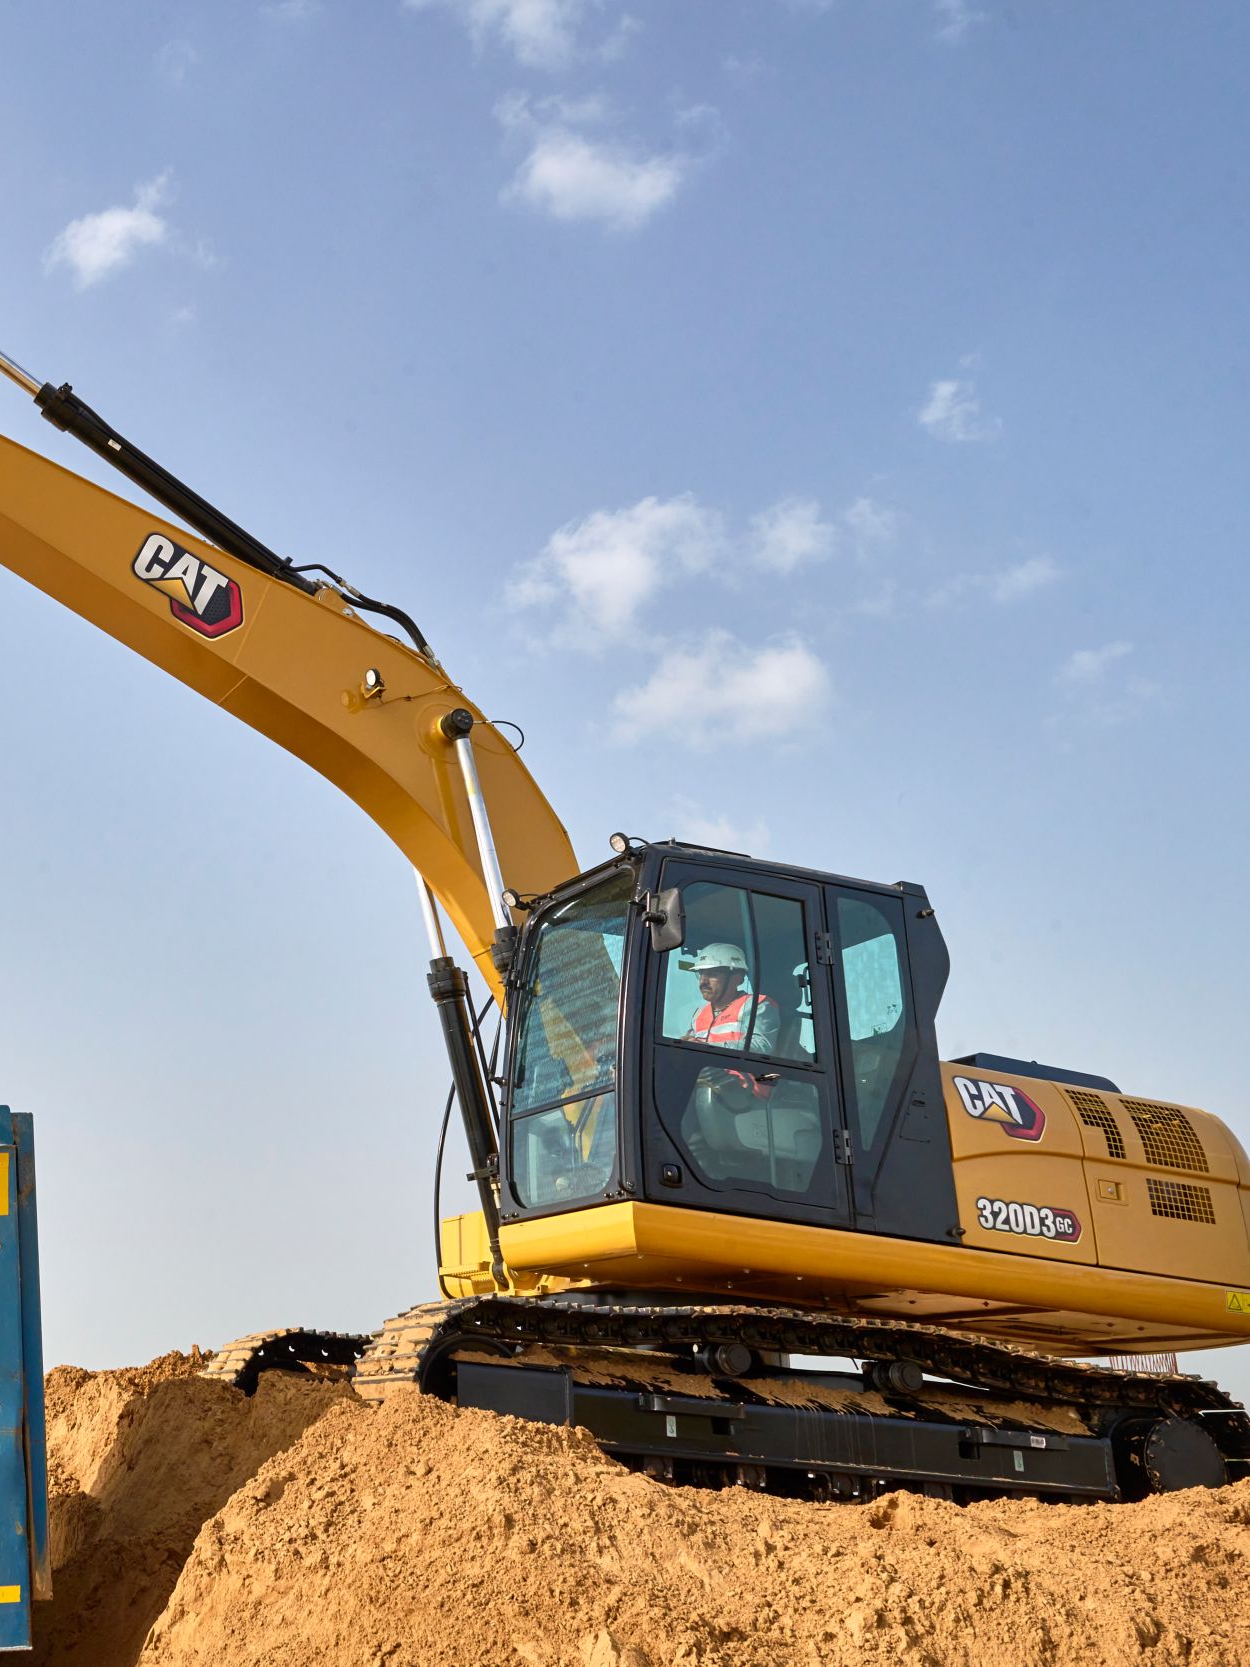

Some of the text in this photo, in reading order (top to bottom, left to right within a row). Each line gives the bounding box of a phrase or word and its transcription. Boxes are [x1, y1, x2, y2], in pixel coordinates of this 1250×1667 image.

[134, 534, 229, 615] CAT
[953, 1076, 1023, 1125] CAT
[977, 1198, 1073, 1238] 320D3 GC
